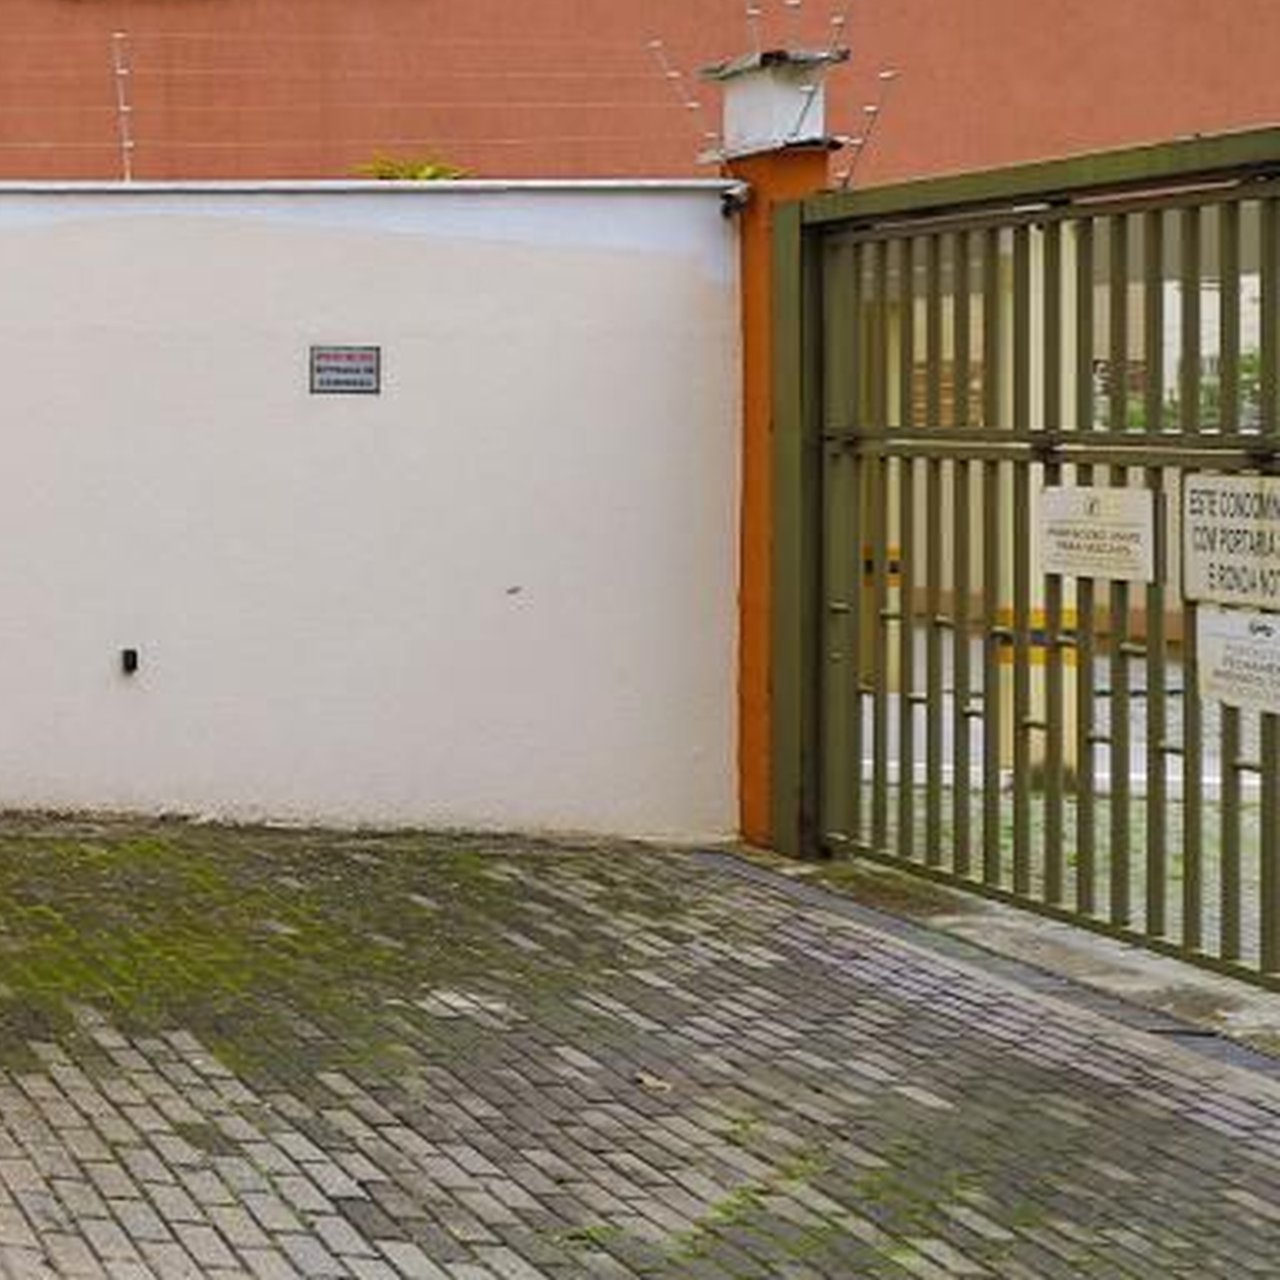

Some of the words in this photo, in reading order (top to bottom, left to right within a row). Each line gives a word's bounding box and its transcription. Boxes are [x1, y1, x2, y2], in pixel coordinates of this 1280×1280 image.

[1189, 487, 1217, 518] ESTE
[1192, 525, 1218, 553] COM
[1220, 527, 1276, 557] PORTARIA
